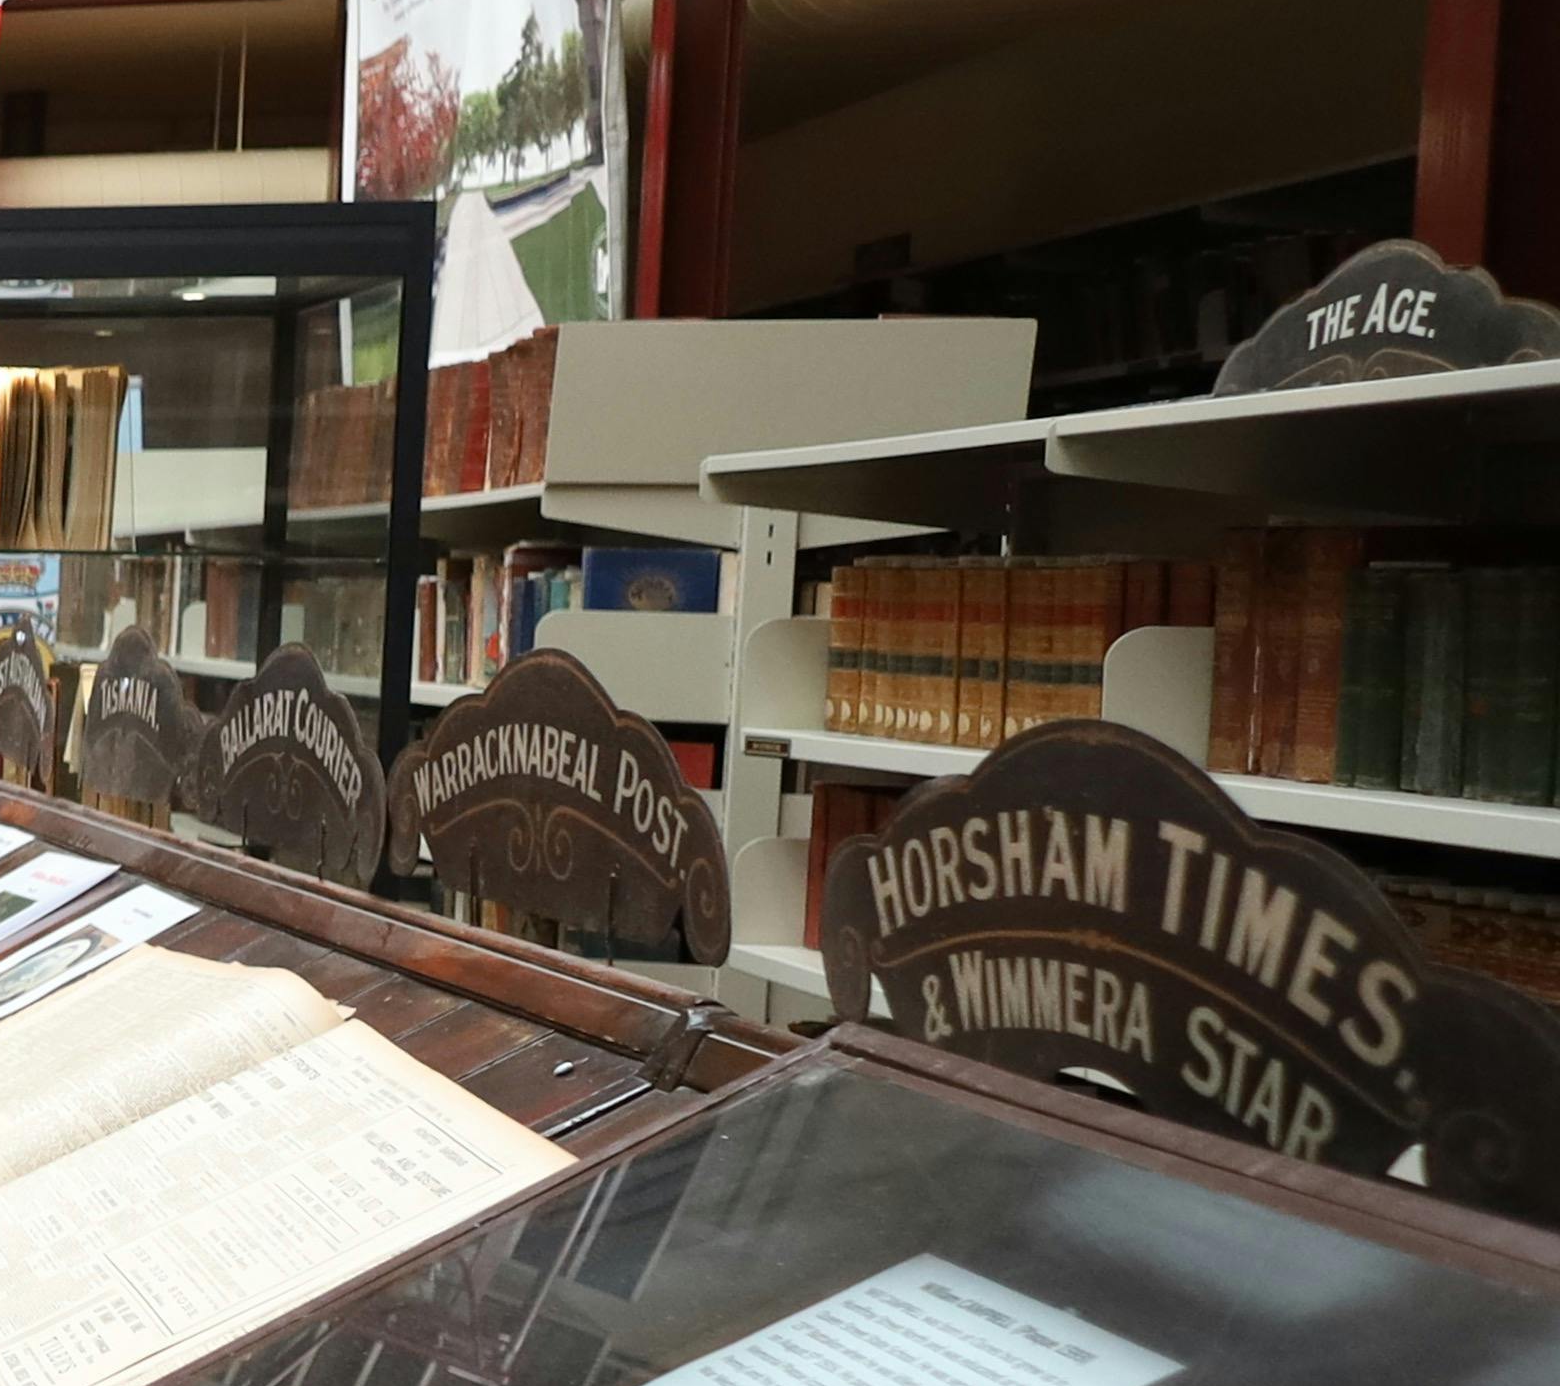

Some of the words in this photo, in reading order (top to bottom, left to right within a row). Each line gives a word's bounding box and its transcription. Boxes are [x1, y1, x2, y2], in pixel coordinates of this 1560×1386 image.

[1307, 294, 1362, 351] THE
[1361, 283, 1437, 339] AGE.
[219, 689, 295, 776] BALLARAT
[293, 687, 363, 809] COURIER
[413, 723, 602, 817] WARRACKNABEAL
[613, 748, 689, 879] POST.
[867, 807, 1131, 937] HORSHAM
[1157, 820, 1419, 1090] TIMES.
[922, 974, 953, 1043] &
[949, 950, 1155, 1064] WIMMERA
[1180, 1006, 1337, 1162] STAR
